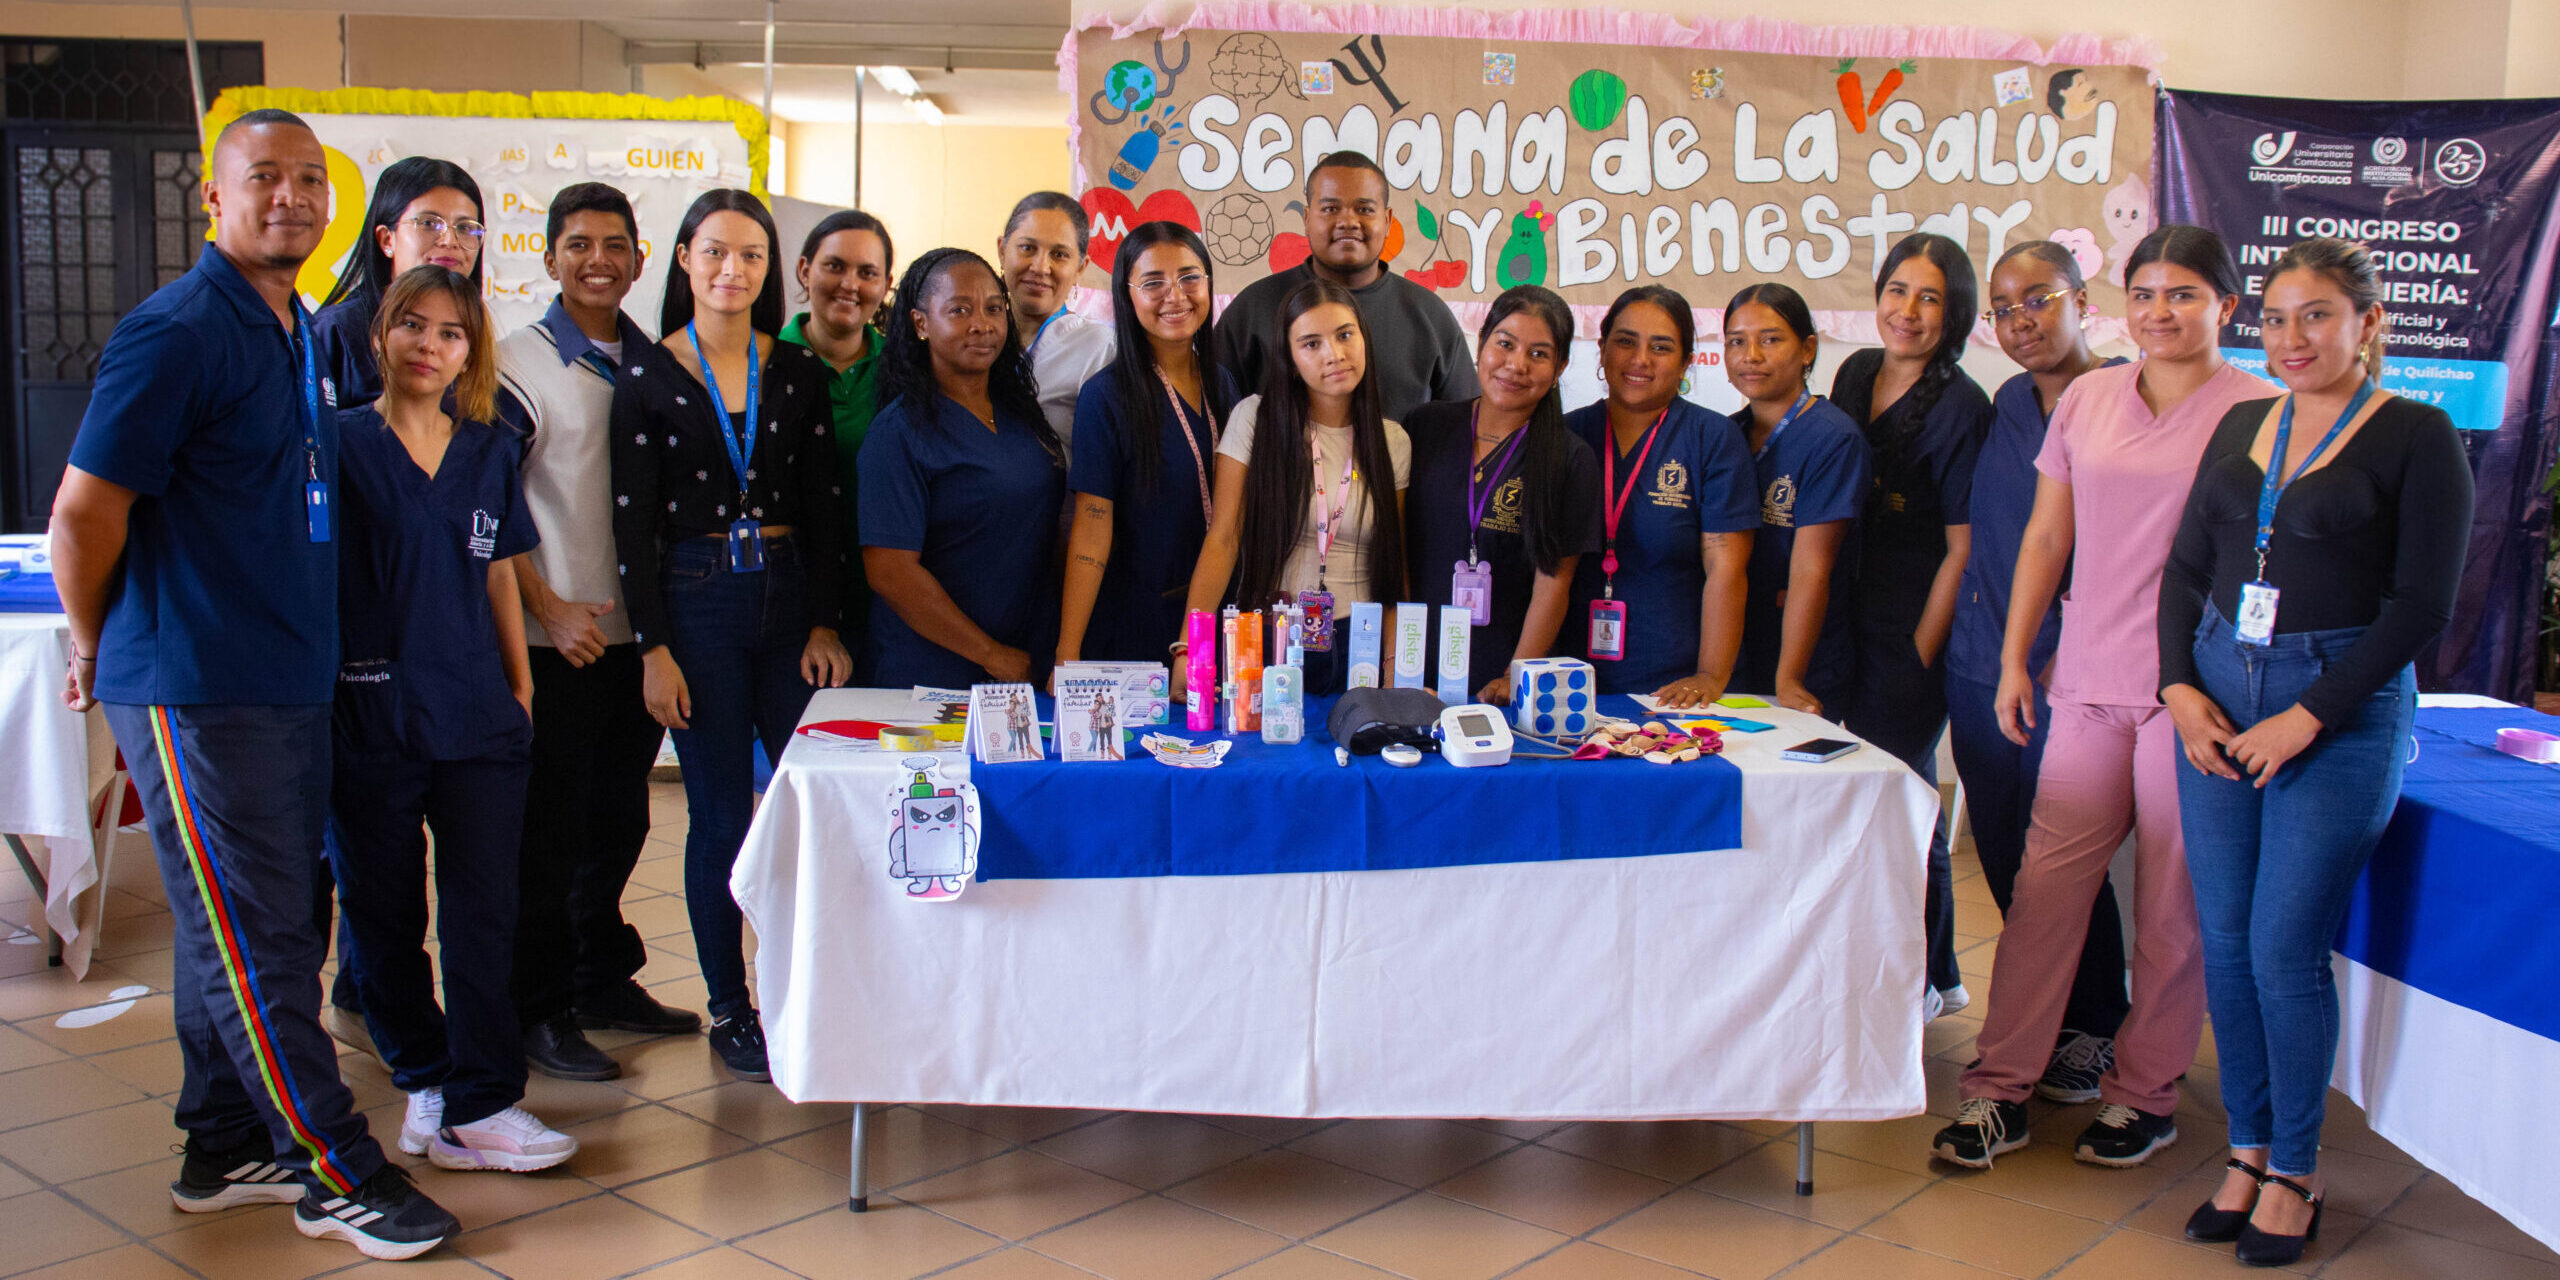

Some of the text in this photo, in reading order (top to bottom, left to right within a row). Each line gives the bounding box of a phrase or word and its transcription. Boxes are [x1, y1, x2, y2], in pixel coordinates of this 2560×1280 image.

[1590, 95, 1710, 197] de
[554, 143, 567, 159] A
[627, 147, 704, 171] GUIEN
[2294, 157, 2354, 168] Comfacauca
[2248, 170, 2352, 185] Unicomfacauca
[2262, 215, 2461, 243] III CONGRESO
[2381, 312, 2448, 331] ificial y
[2379, 331, 2470, 350] ecnológica
[2404, 366, 2475, 381] Quilichao
[2432, 389, 2445, 404] y
[1403, 623, 1422, 667] glister
[1447, 625, 1465, 669] glister
[339, 671, 391, 683] Psicología
